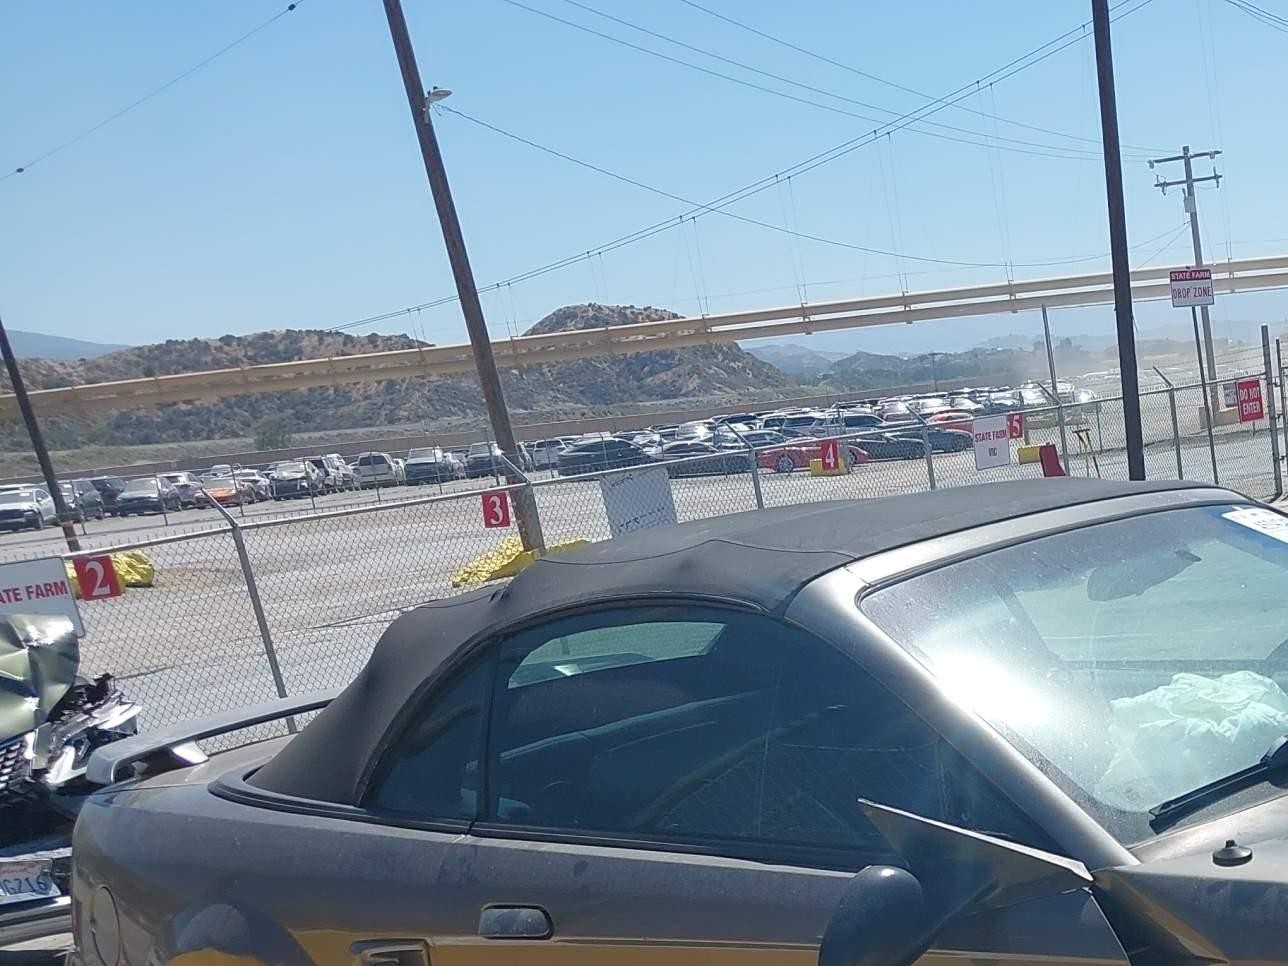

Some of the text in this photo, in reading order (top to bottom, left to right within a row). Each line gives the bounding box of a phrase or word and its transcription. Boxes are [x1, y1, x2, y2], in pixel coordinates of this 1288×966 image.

[1171, 270, 1211, 280] STATE FARM
[1172, 286, 1212, 299] DROP ZONE
[1239, 388, 1249, 401] DO
[1249, 386, 1260, 399] NOT
[1242, 400, 1261, 415] ENTER
[1012, 414, 1021, 437] 5
[974, 429, 1007, 443] STATE FARM
[825, 442, 835, 468] 4
[489, 495, 504, 525] 3
[85, 560, 111, 597] 2
[25, 580, 69, 600] FARM
